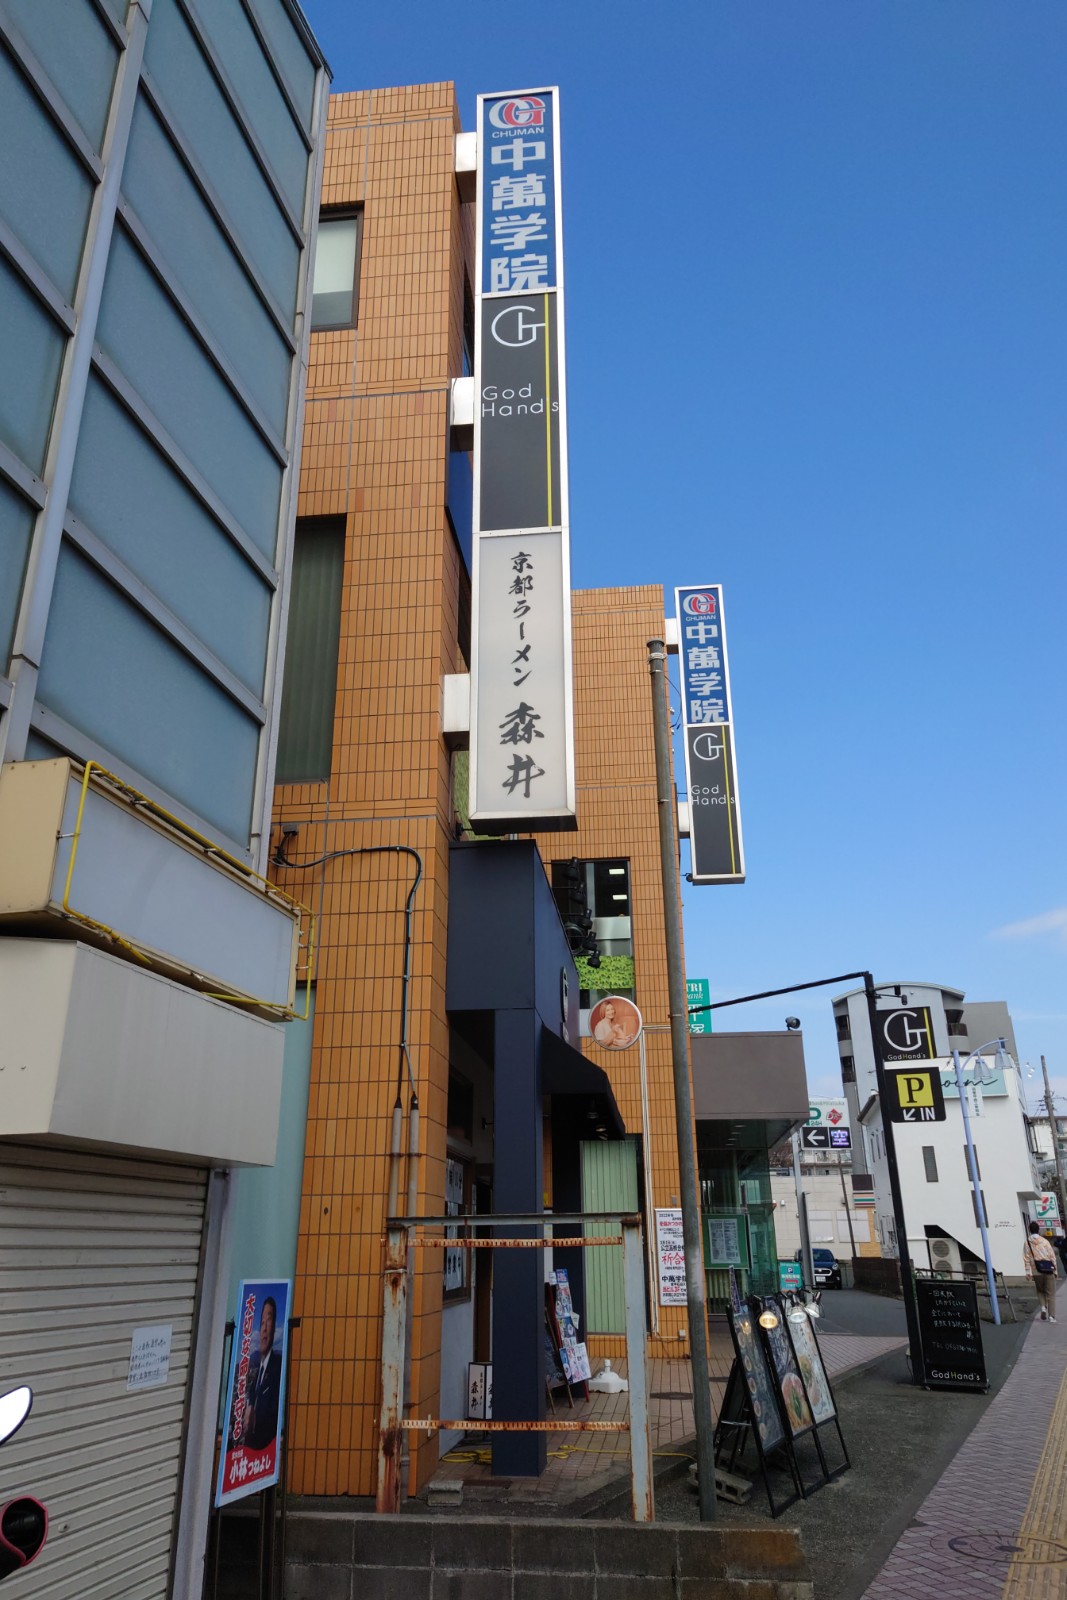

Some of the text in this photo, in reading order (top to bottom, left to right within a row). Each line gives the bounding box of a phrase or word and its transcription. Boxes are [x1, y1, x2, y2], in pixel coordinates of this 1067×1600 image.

[492, 127, 545, 138] CHUMAN
[490, 138, 548, 292] 中萬学院
[482, 383, 532, 400] God
[685, 614, 717, 622] CHUMAN
[498, 551, 546, 799] 京都ラーメン 森井
[685, 621, 725, 723] 中萬学院
[690, 785, 719, 795] God
[903, 1077, 924, 1104] P
[920, 1107, 936, 1121] IN
[831, 1130, 850, 1146] 空
[931, 1370, 981, 1381] GodHand's
